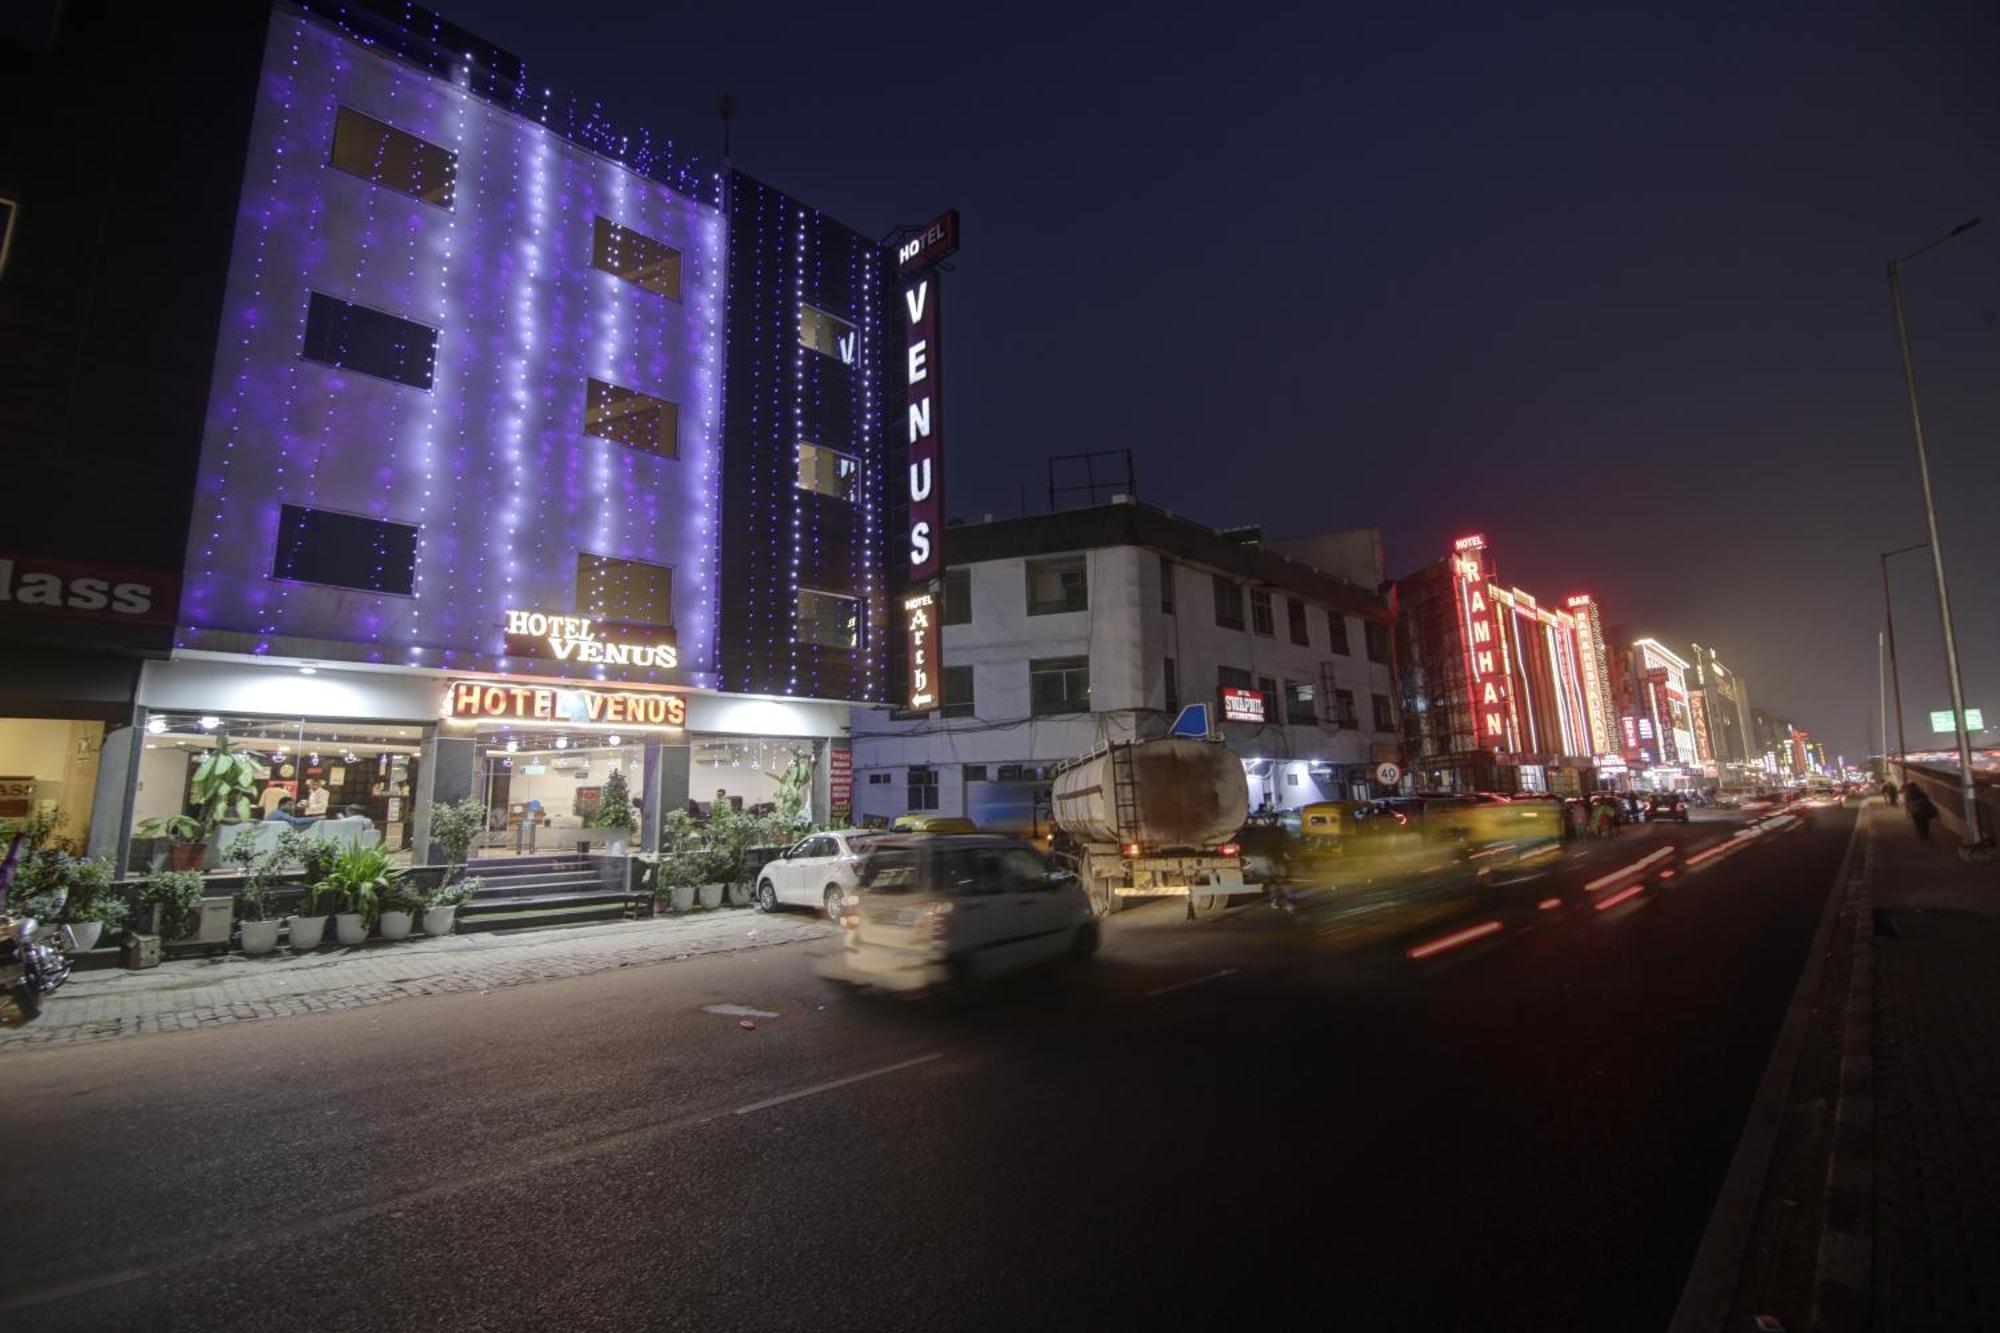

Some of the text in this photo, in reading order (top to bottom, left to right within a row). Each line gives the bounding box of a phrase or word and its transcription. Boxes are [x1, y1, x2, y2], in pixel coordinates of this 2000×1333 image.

[900, 225, 945, 265] HOTEL
[906, 281, 932, 564] VENUS
[1456, 536, 1484, 550] HOTEL
[905, 595, 933, 611] HOTEL
[1568, 595, 1589, 607] BAR
[506, 611, 595, 641] HOTEL
[549, 638, 678, 668] VENUS
[456, 685, 685, 724] HOTEL VENUS
[1380, 768, 1396, 780] 40
